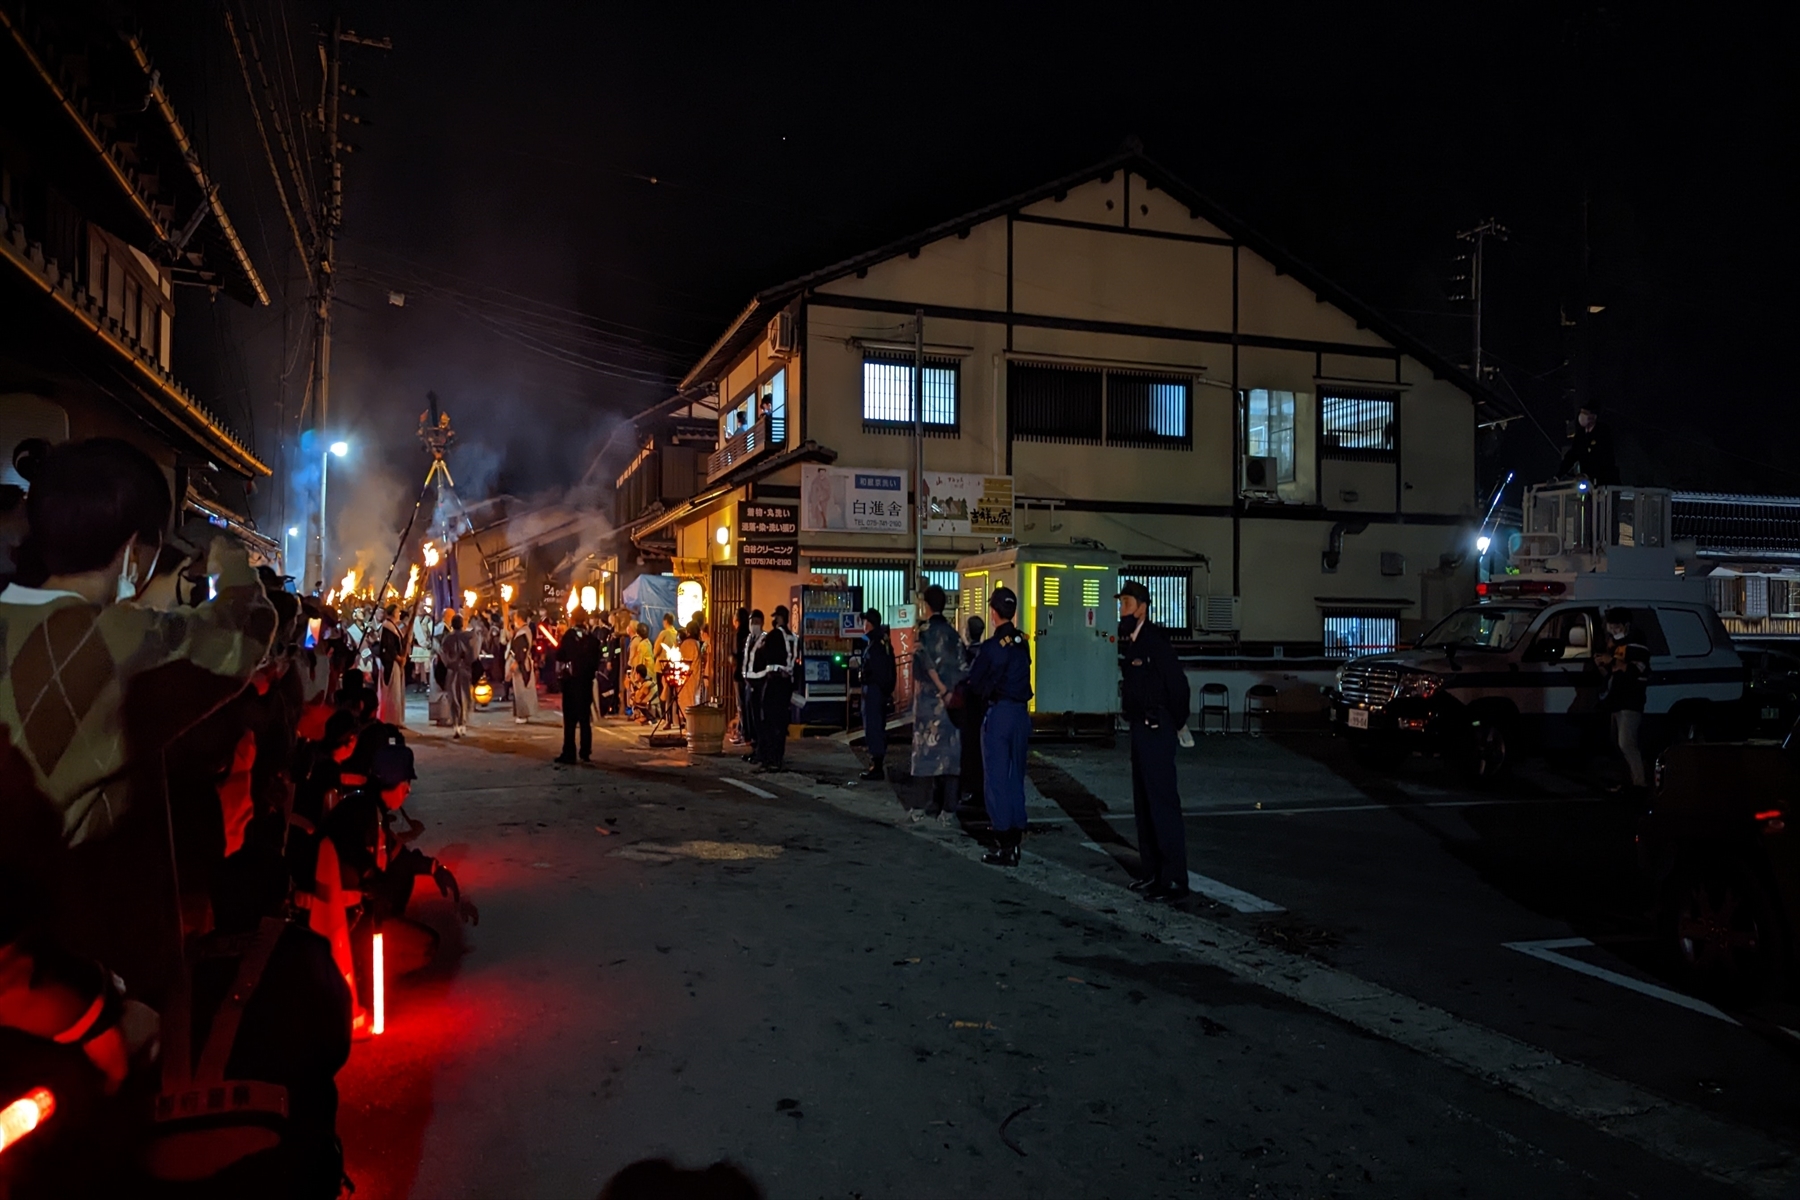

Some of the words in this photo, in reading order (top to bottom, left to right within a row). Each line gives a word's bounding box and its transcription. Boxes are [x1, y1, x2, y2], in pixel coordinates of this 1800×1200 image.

[853, 499, 903, 517] 白進舎
[970, 508, 1011, 526] 吉祥山宿
[743, 545, 793, 554] 白谷クリーニング
